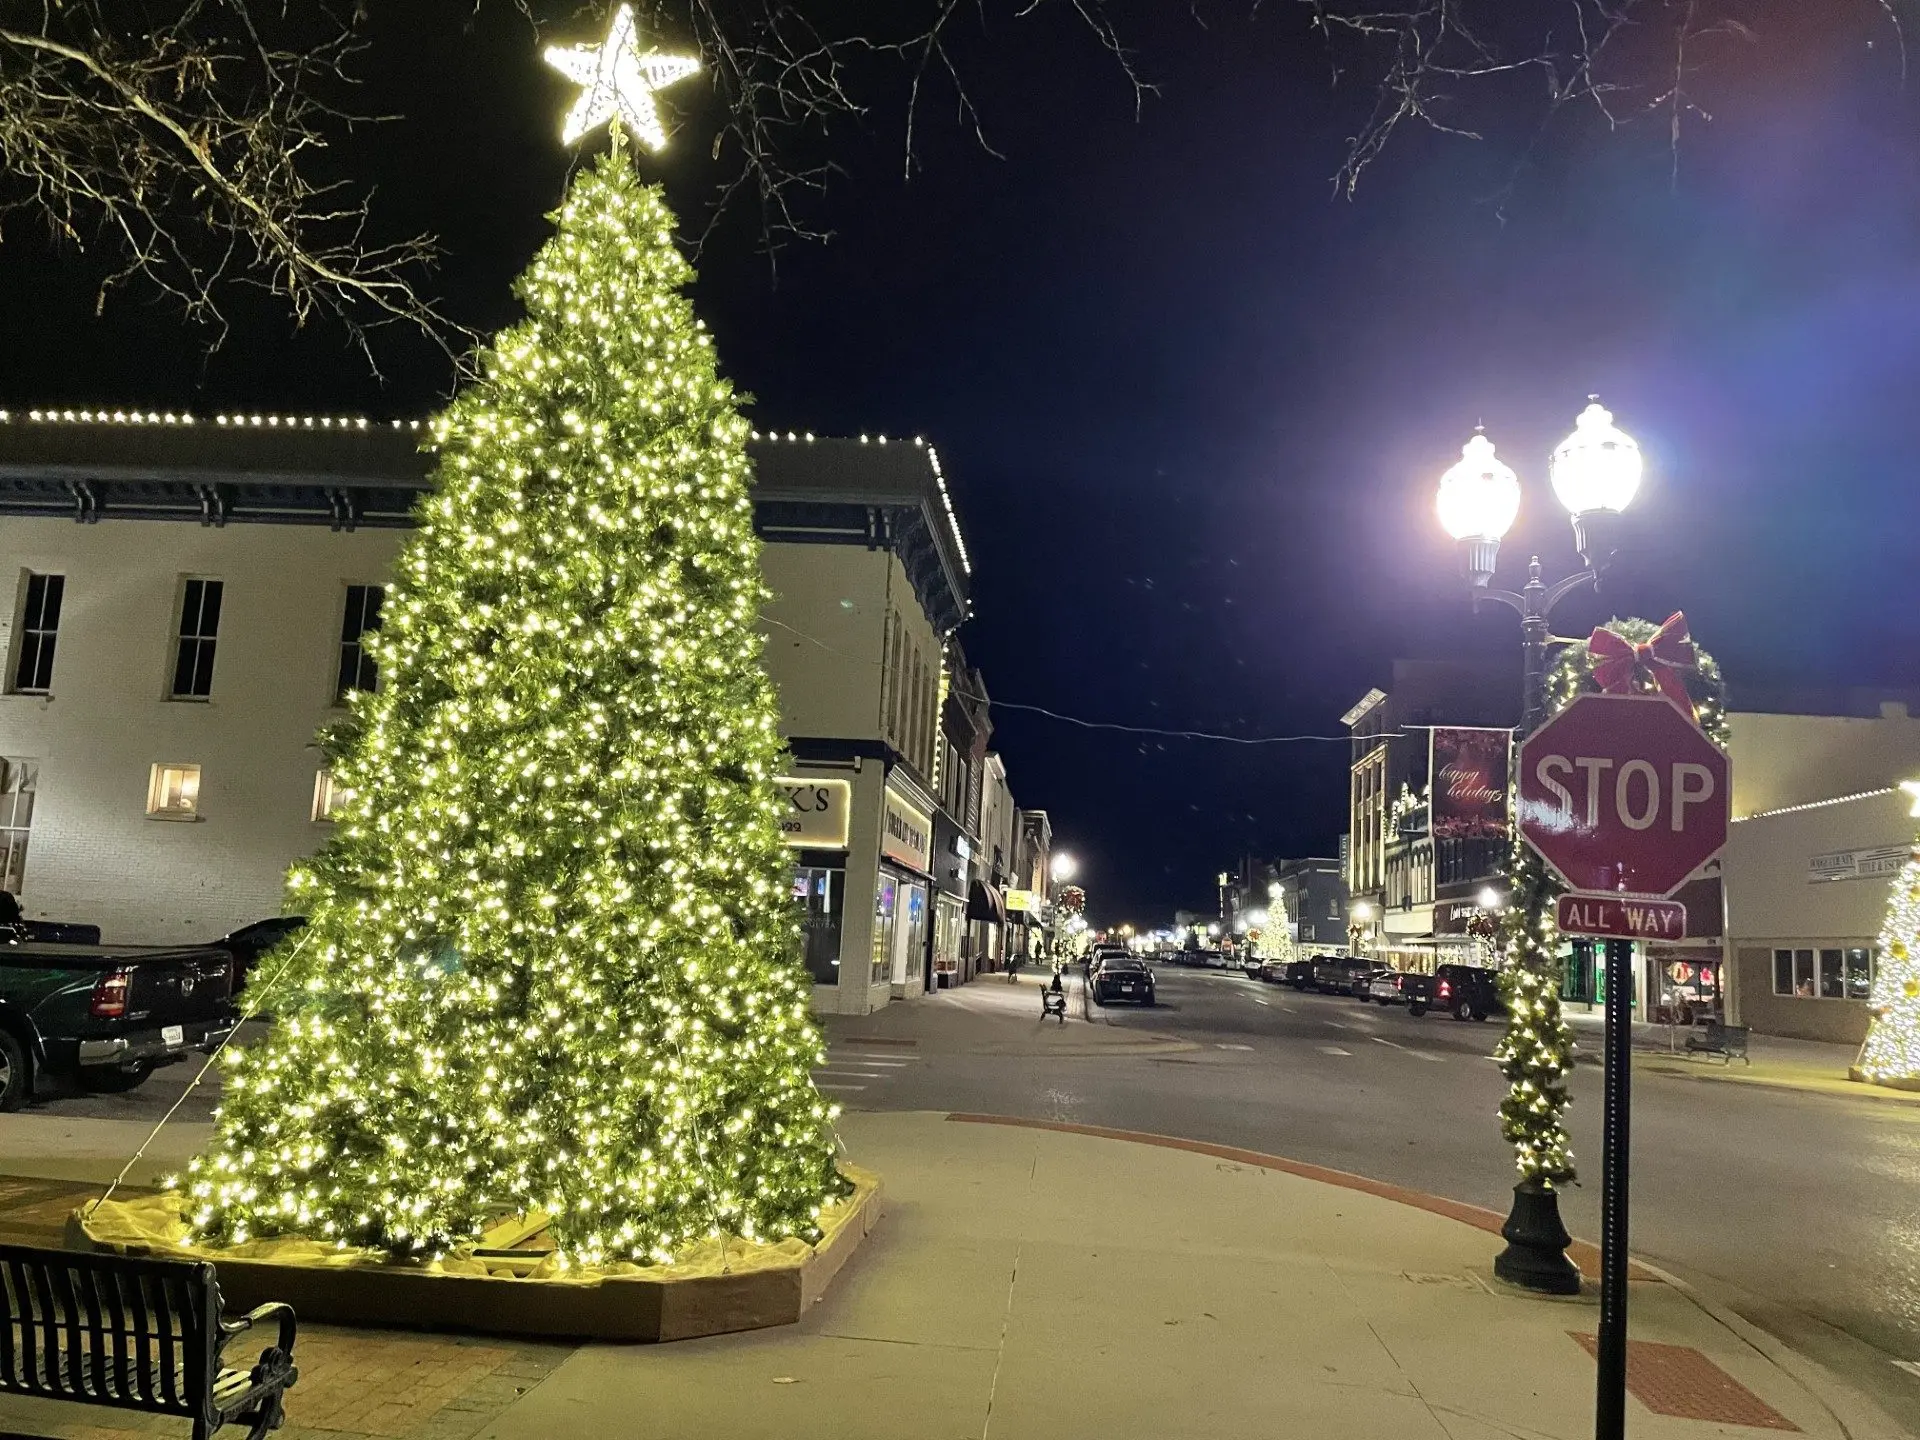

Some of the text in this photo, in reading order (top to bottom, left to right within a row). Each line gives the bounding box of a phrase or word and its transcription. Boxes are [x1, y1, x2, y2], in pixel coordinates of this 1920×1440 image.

[1438, 763, 1480, 785] happy
[783, 784, 830, 813] K'S
[1446, 781, 1506, 804] holidays
[1536, 754, 1715, 832] STOP
[781, 821, 802, 833] 22
[1567, 903, 1674, 933] ALL WAY
